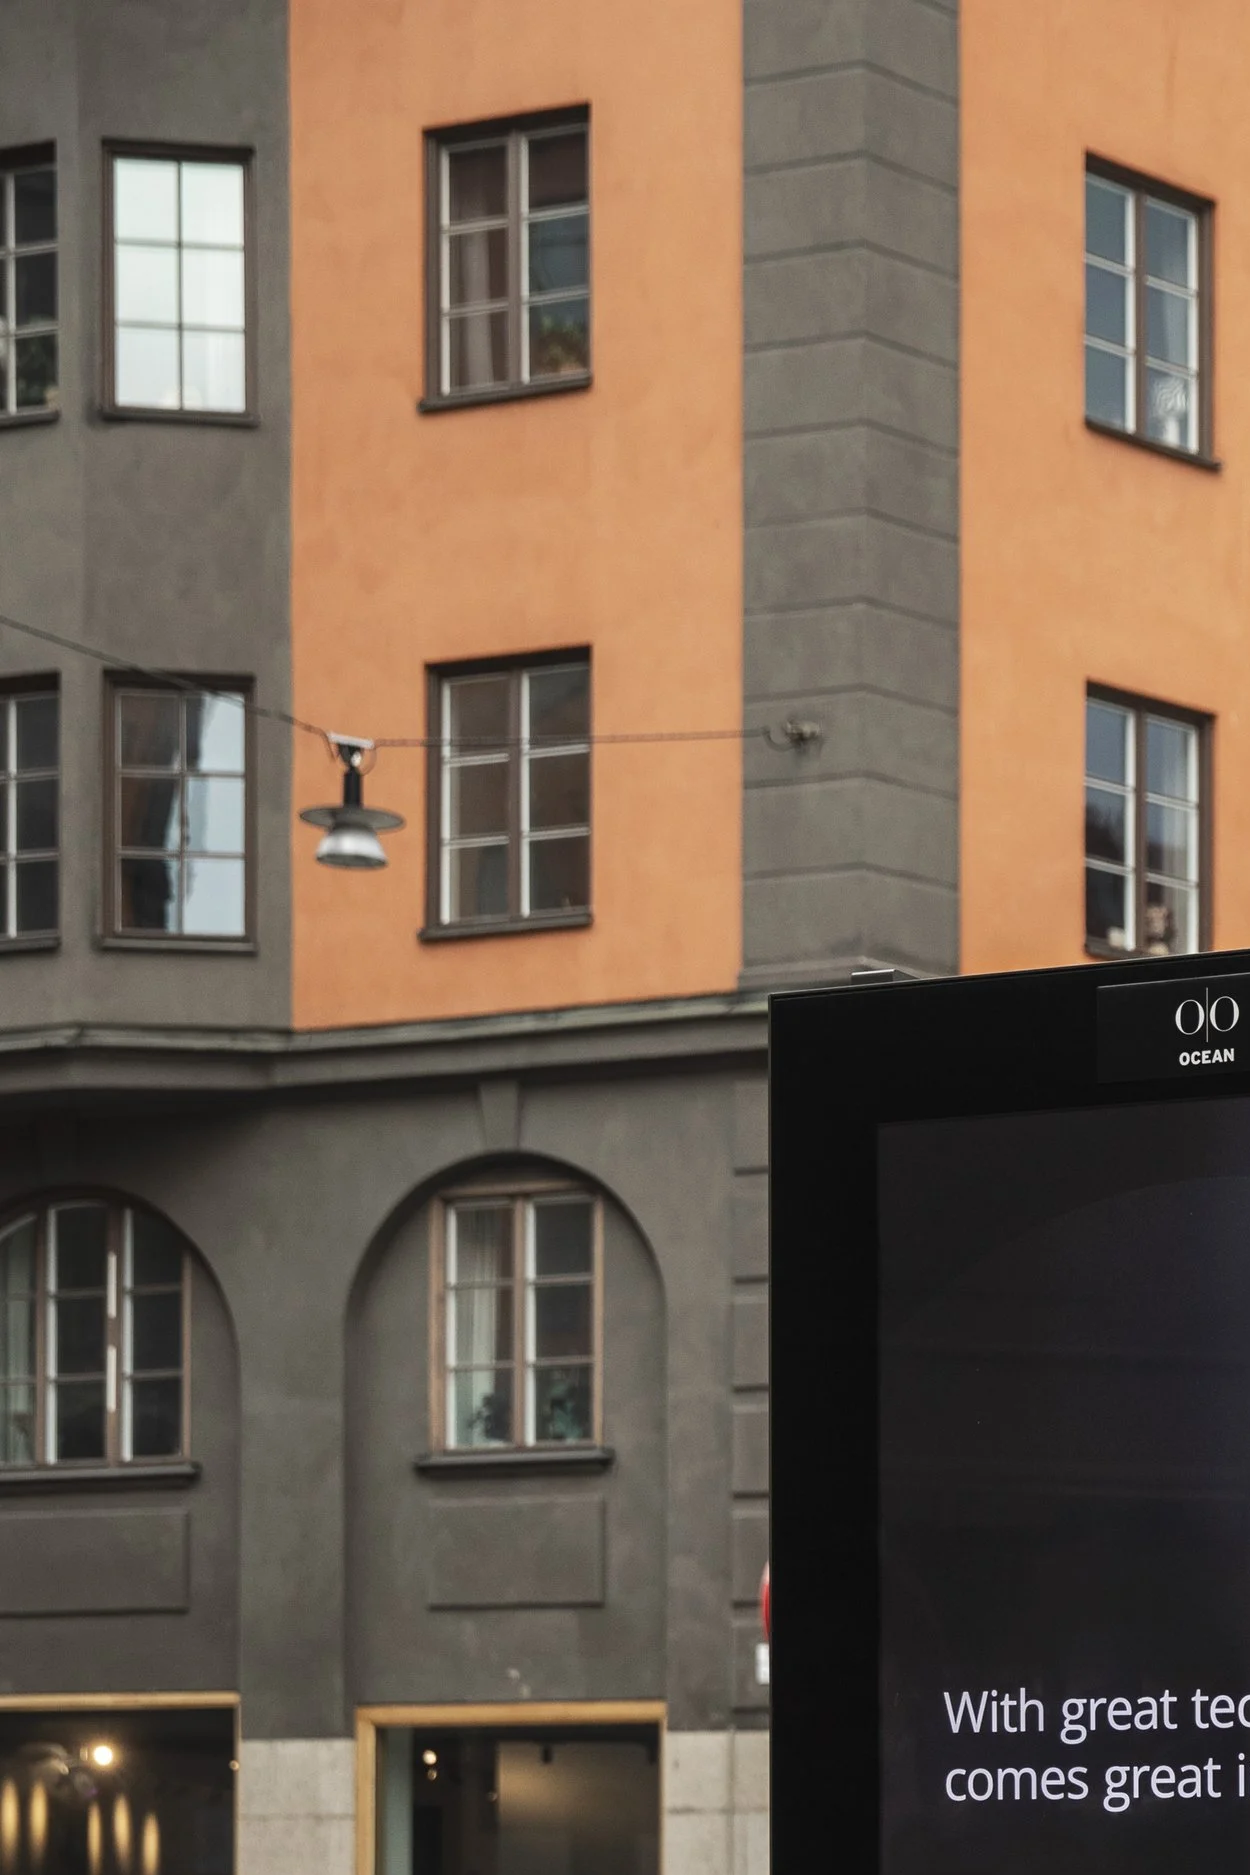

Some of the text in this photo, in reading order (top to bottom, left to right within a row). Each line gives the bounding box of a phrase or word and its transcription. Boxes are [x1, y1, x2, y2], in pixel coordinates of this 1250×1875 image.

[1178, 1047, 1236, 1067] OCEAN
[943, 1687, 1045, 1734] With
[1059, 1689, 1178, 1745] great
[944, 1766, 1090, 1802] comes
[1102, 1757, 1222, 1813] great
